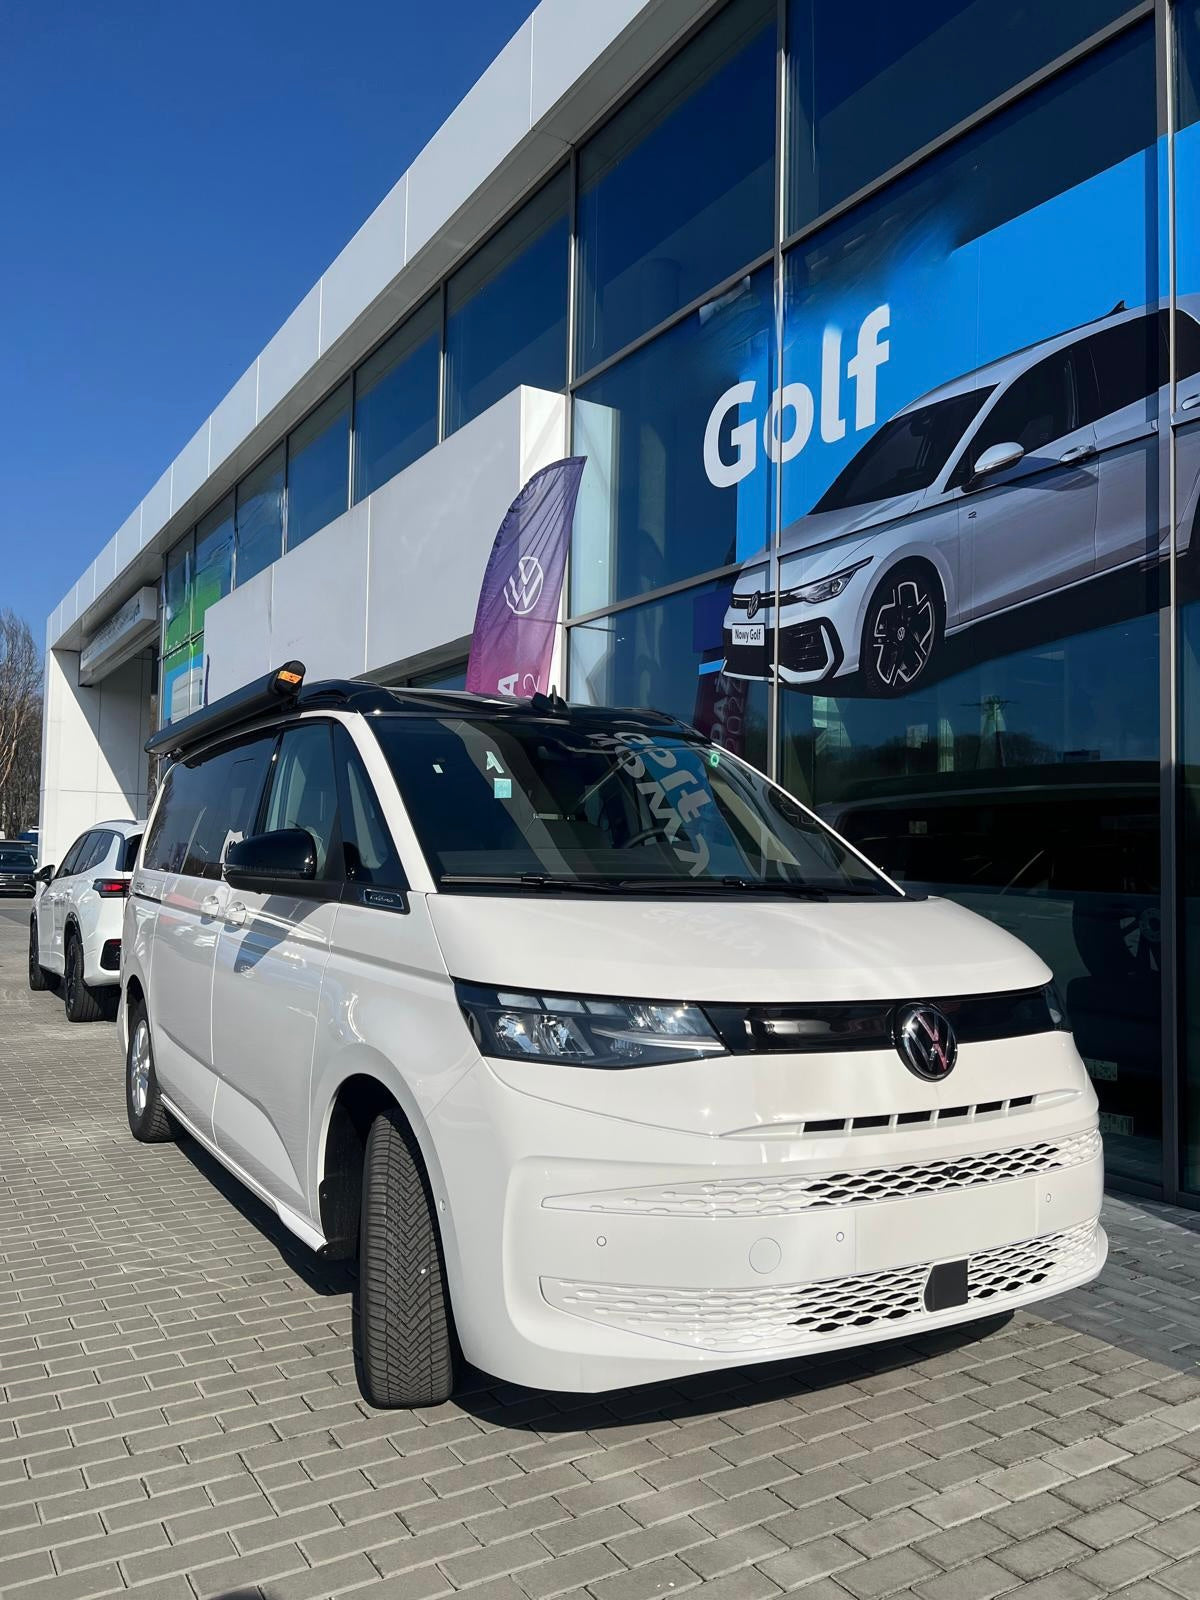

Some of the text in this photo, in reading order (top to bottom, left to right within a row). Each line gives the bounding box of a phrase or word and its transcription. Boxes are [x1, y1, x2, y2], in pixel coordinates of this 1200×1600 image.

[703, 303, 890, 488] Golf
[735, 628, 761, 643] Nowy Golf
